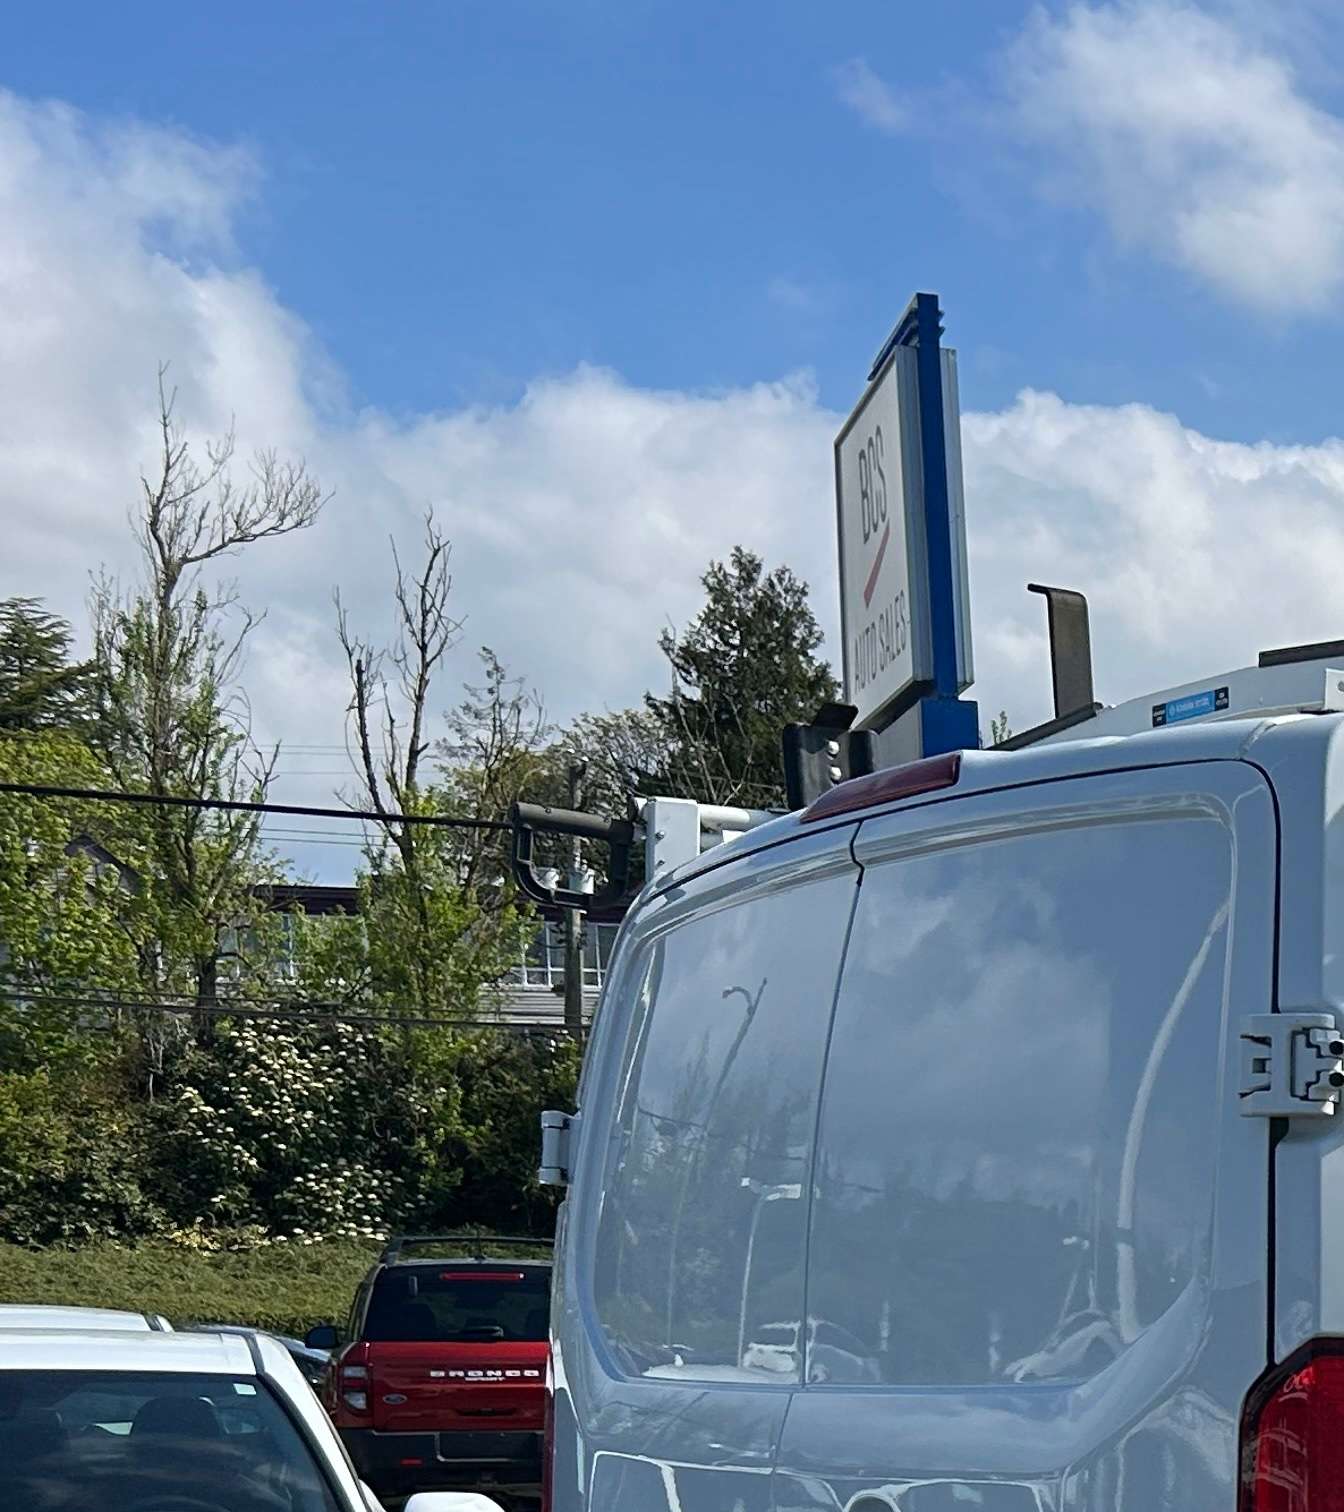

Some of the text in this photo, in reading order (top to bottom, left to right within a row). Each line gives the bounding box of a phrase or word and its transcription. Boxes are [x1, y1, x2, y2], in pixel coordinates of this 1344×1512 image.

[858, 424, 888, 545] BCS
[853, 590, 907, 695] AUTO SALES
